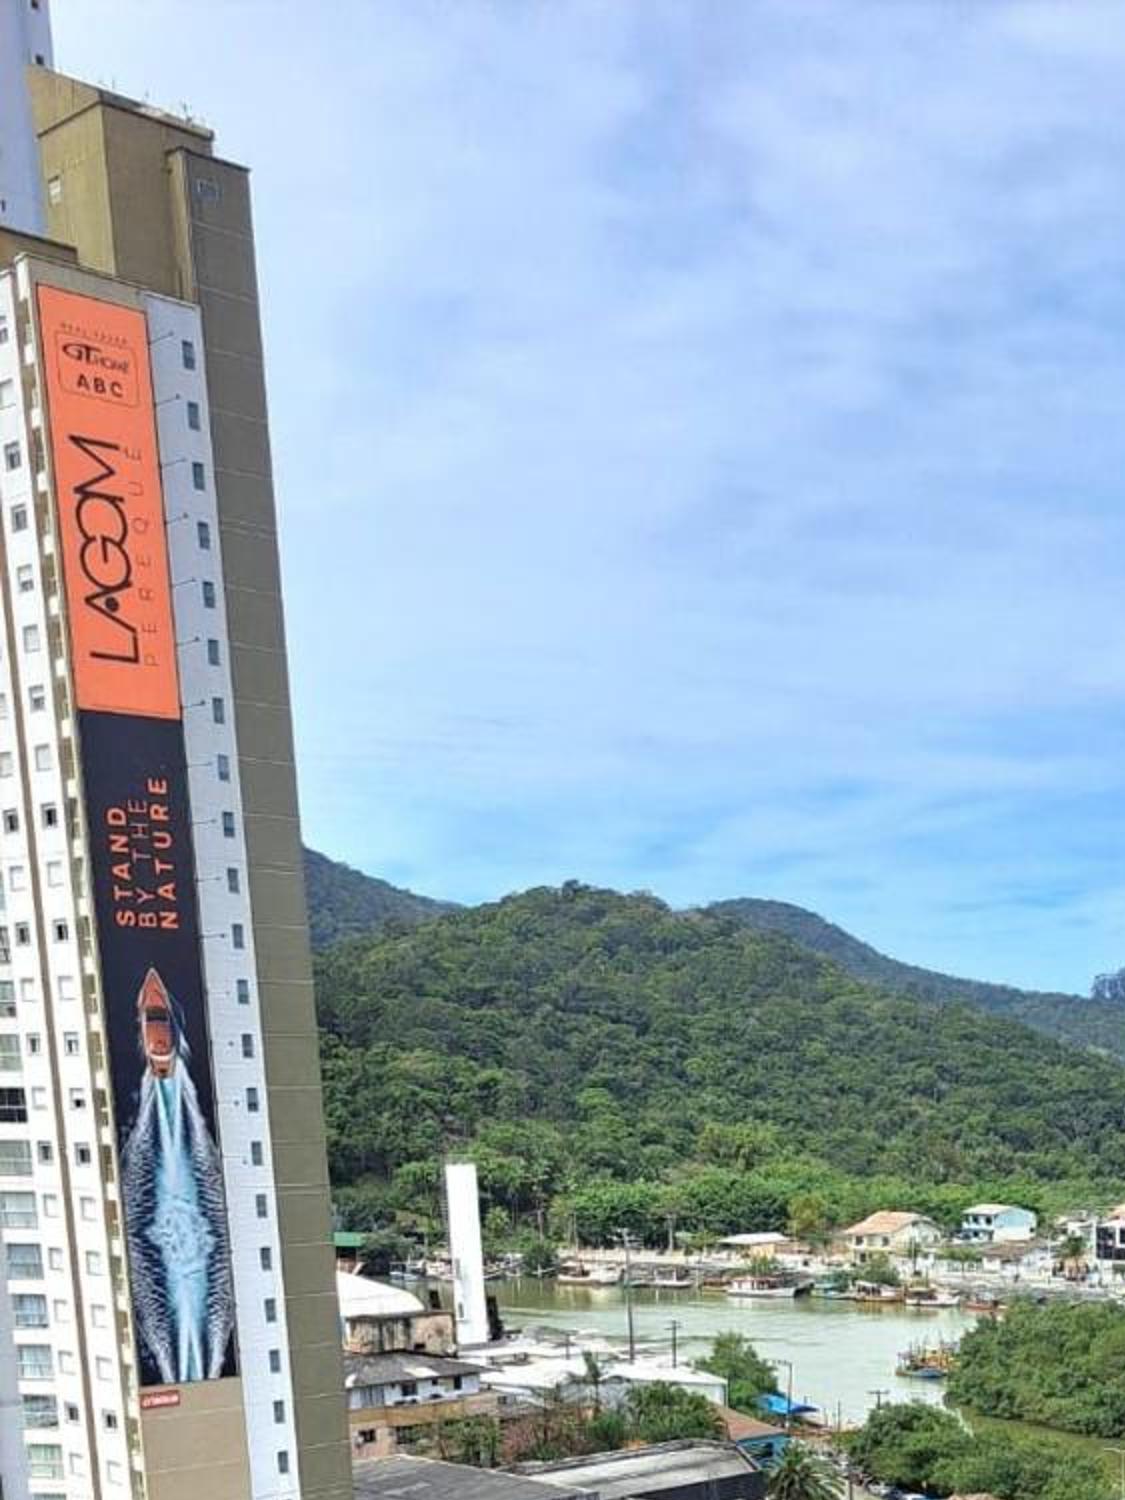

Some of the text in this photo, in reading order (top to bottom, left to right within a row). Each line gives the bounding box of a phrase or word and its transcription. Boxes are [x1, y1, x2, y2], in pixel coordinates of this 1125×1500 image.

[77, 373, 124, 398] ABC
[68, 434, 139, 664] LAGOM
[106, 806, 136, 928] STAND
[128, 799, 158, 929] BY THE
[148, 777, 179, 930] NATURE
